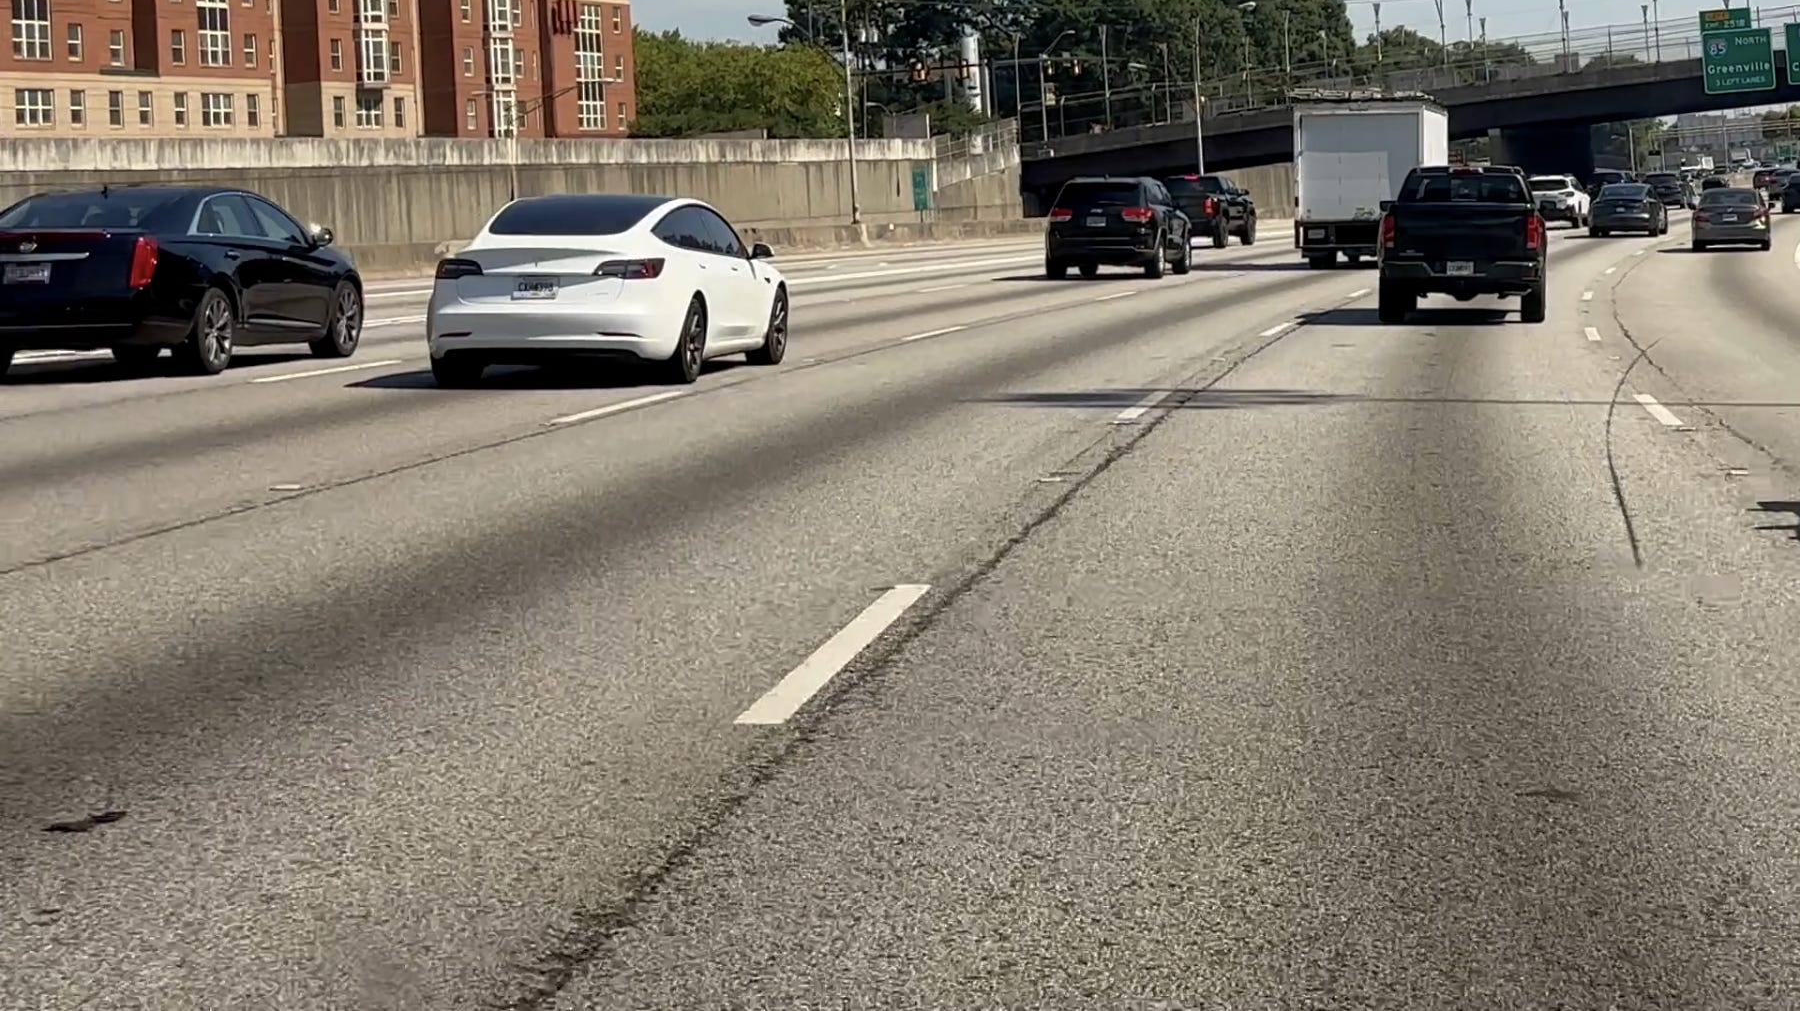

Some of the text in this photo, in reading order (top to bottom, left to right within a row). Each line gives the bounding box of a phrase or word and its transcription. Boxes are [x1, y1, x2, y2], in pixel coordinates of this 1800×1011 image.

[1734, 35, 1767, 46] NORTH
[1709, 42, 1727, 57] 85
[1707, 60, 1770, 75] Greenville
